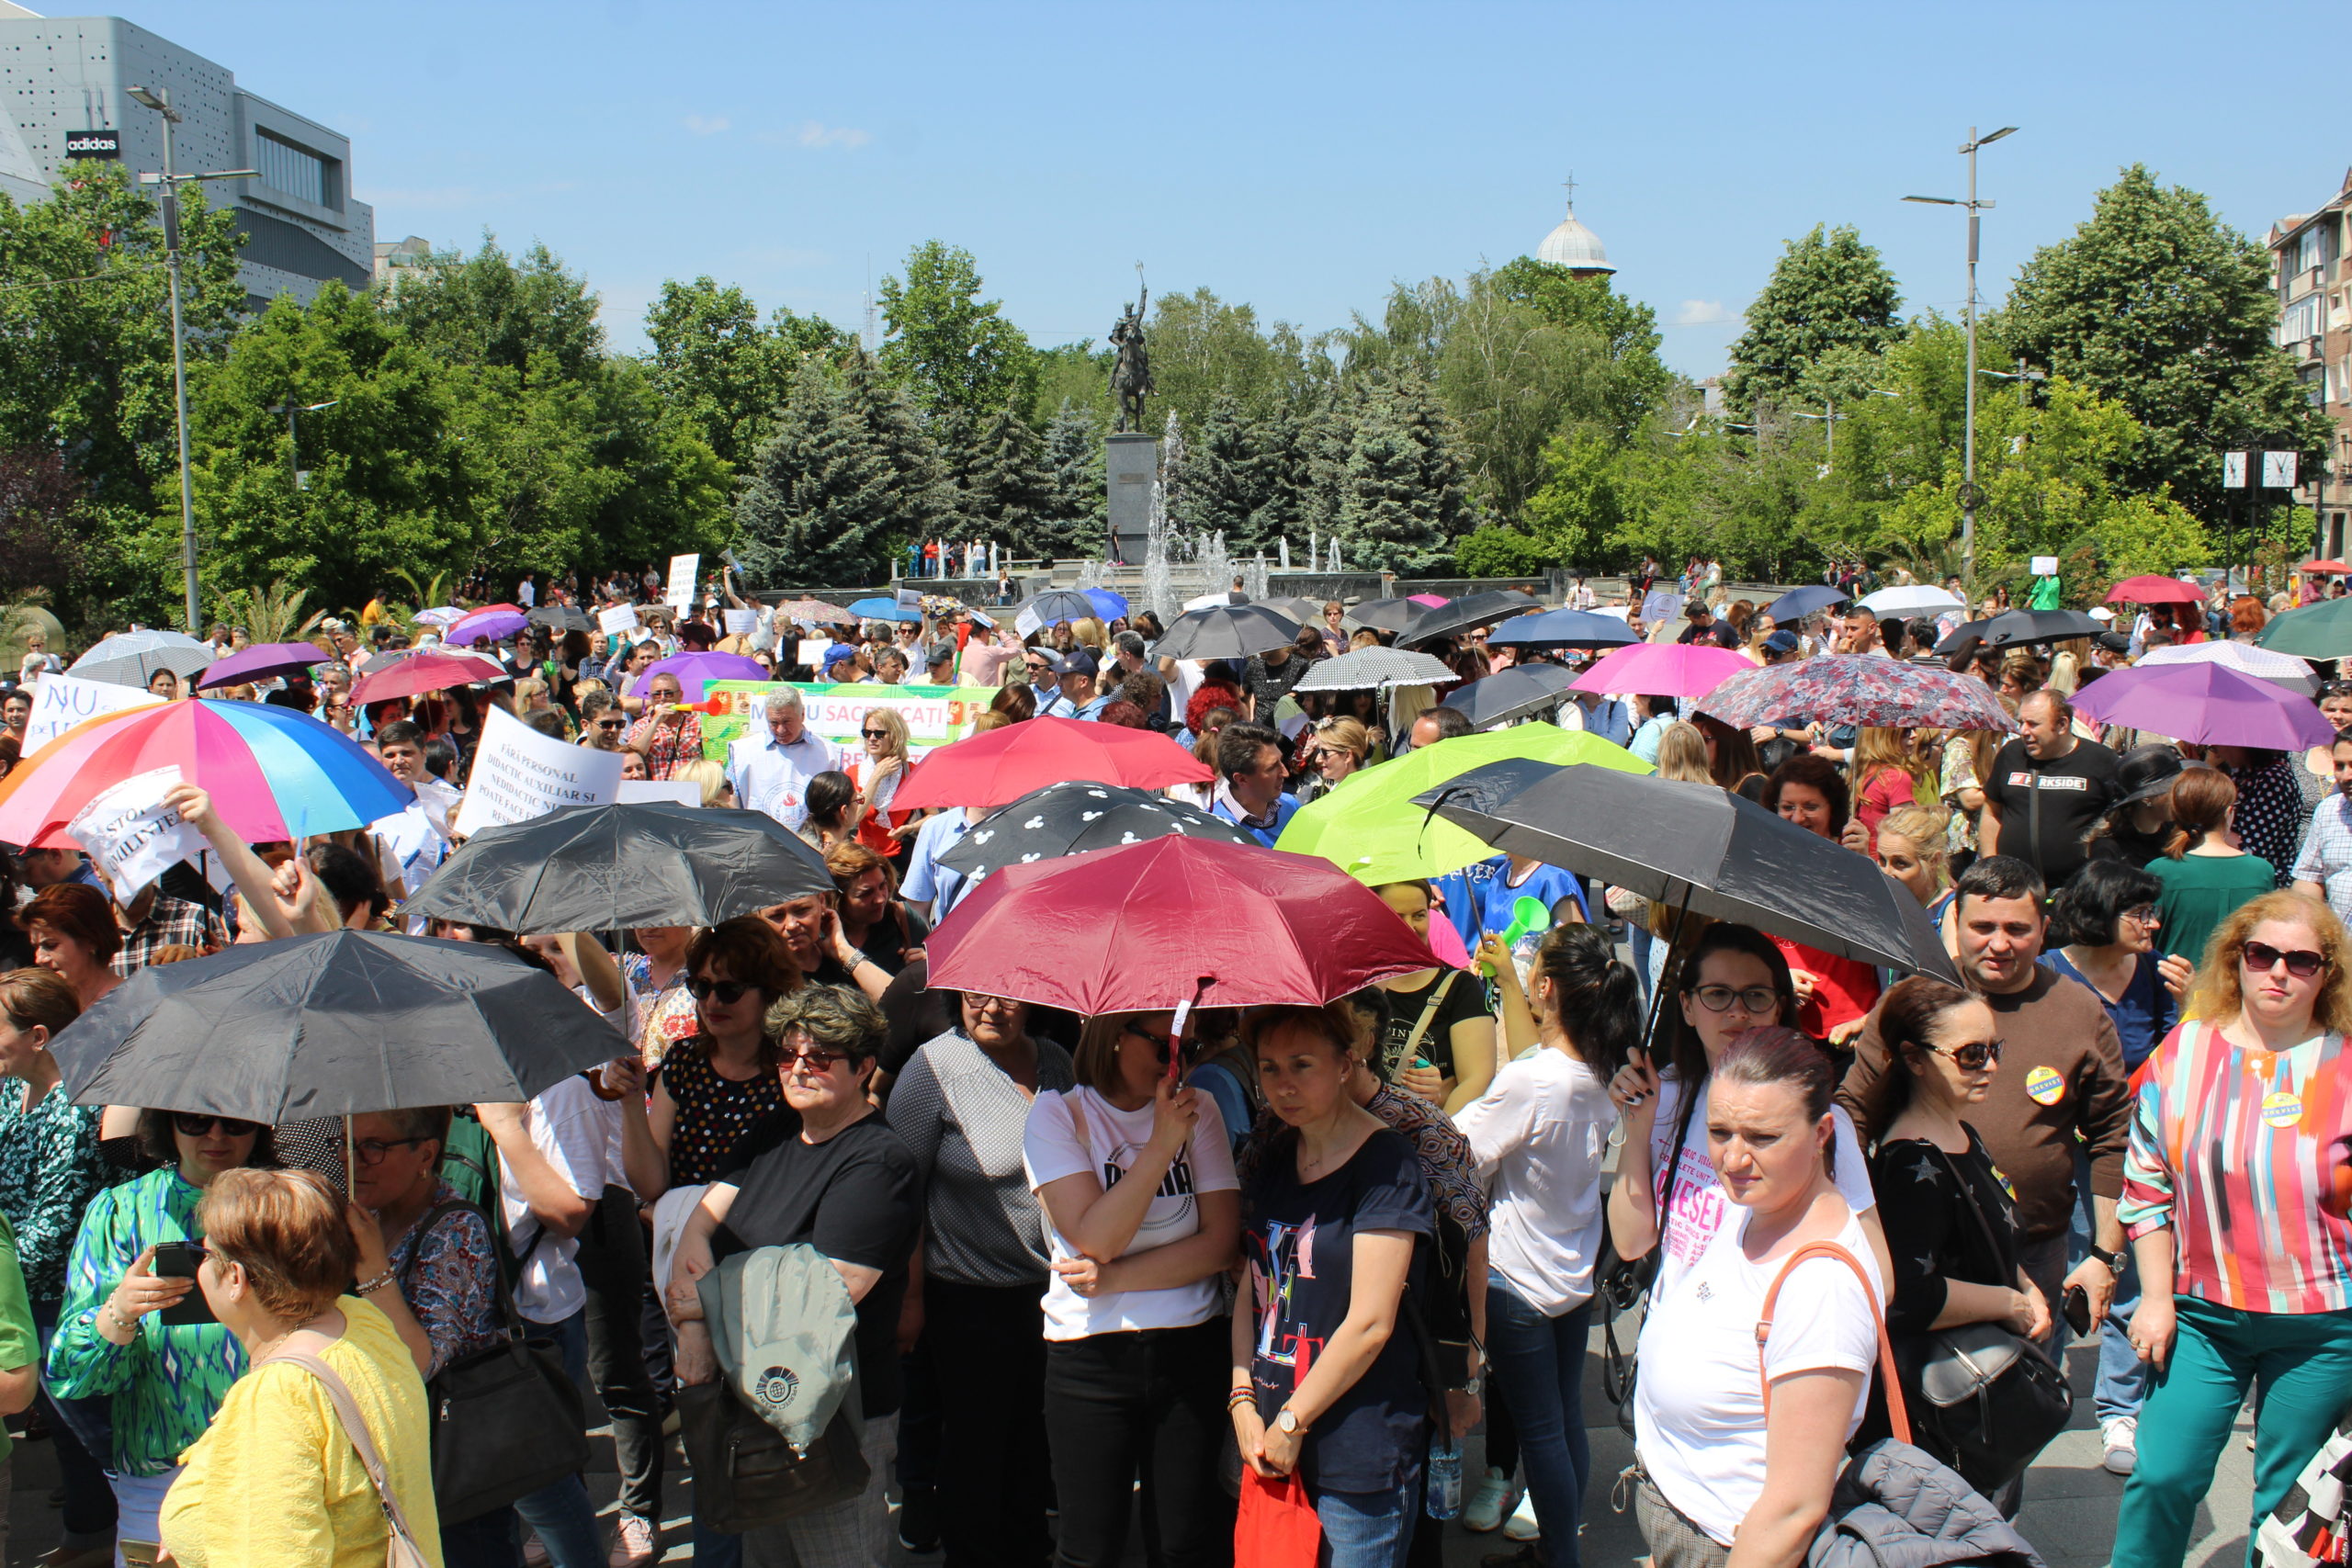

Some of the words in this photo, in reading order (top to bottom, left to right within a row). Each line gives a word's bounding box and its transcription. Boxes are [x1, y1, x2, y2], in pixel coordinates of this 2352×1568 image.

[68, 137, 117, 151] adidas
[44, 684, 96, 716] NU
[487, 752, 522, 781] DIDACTIC
[525, 776, 580, 801] AUXILIAR
[522, 754, 579, 784] PERSONAL
[492, 773, 539, 807] NEDIDACTIC
